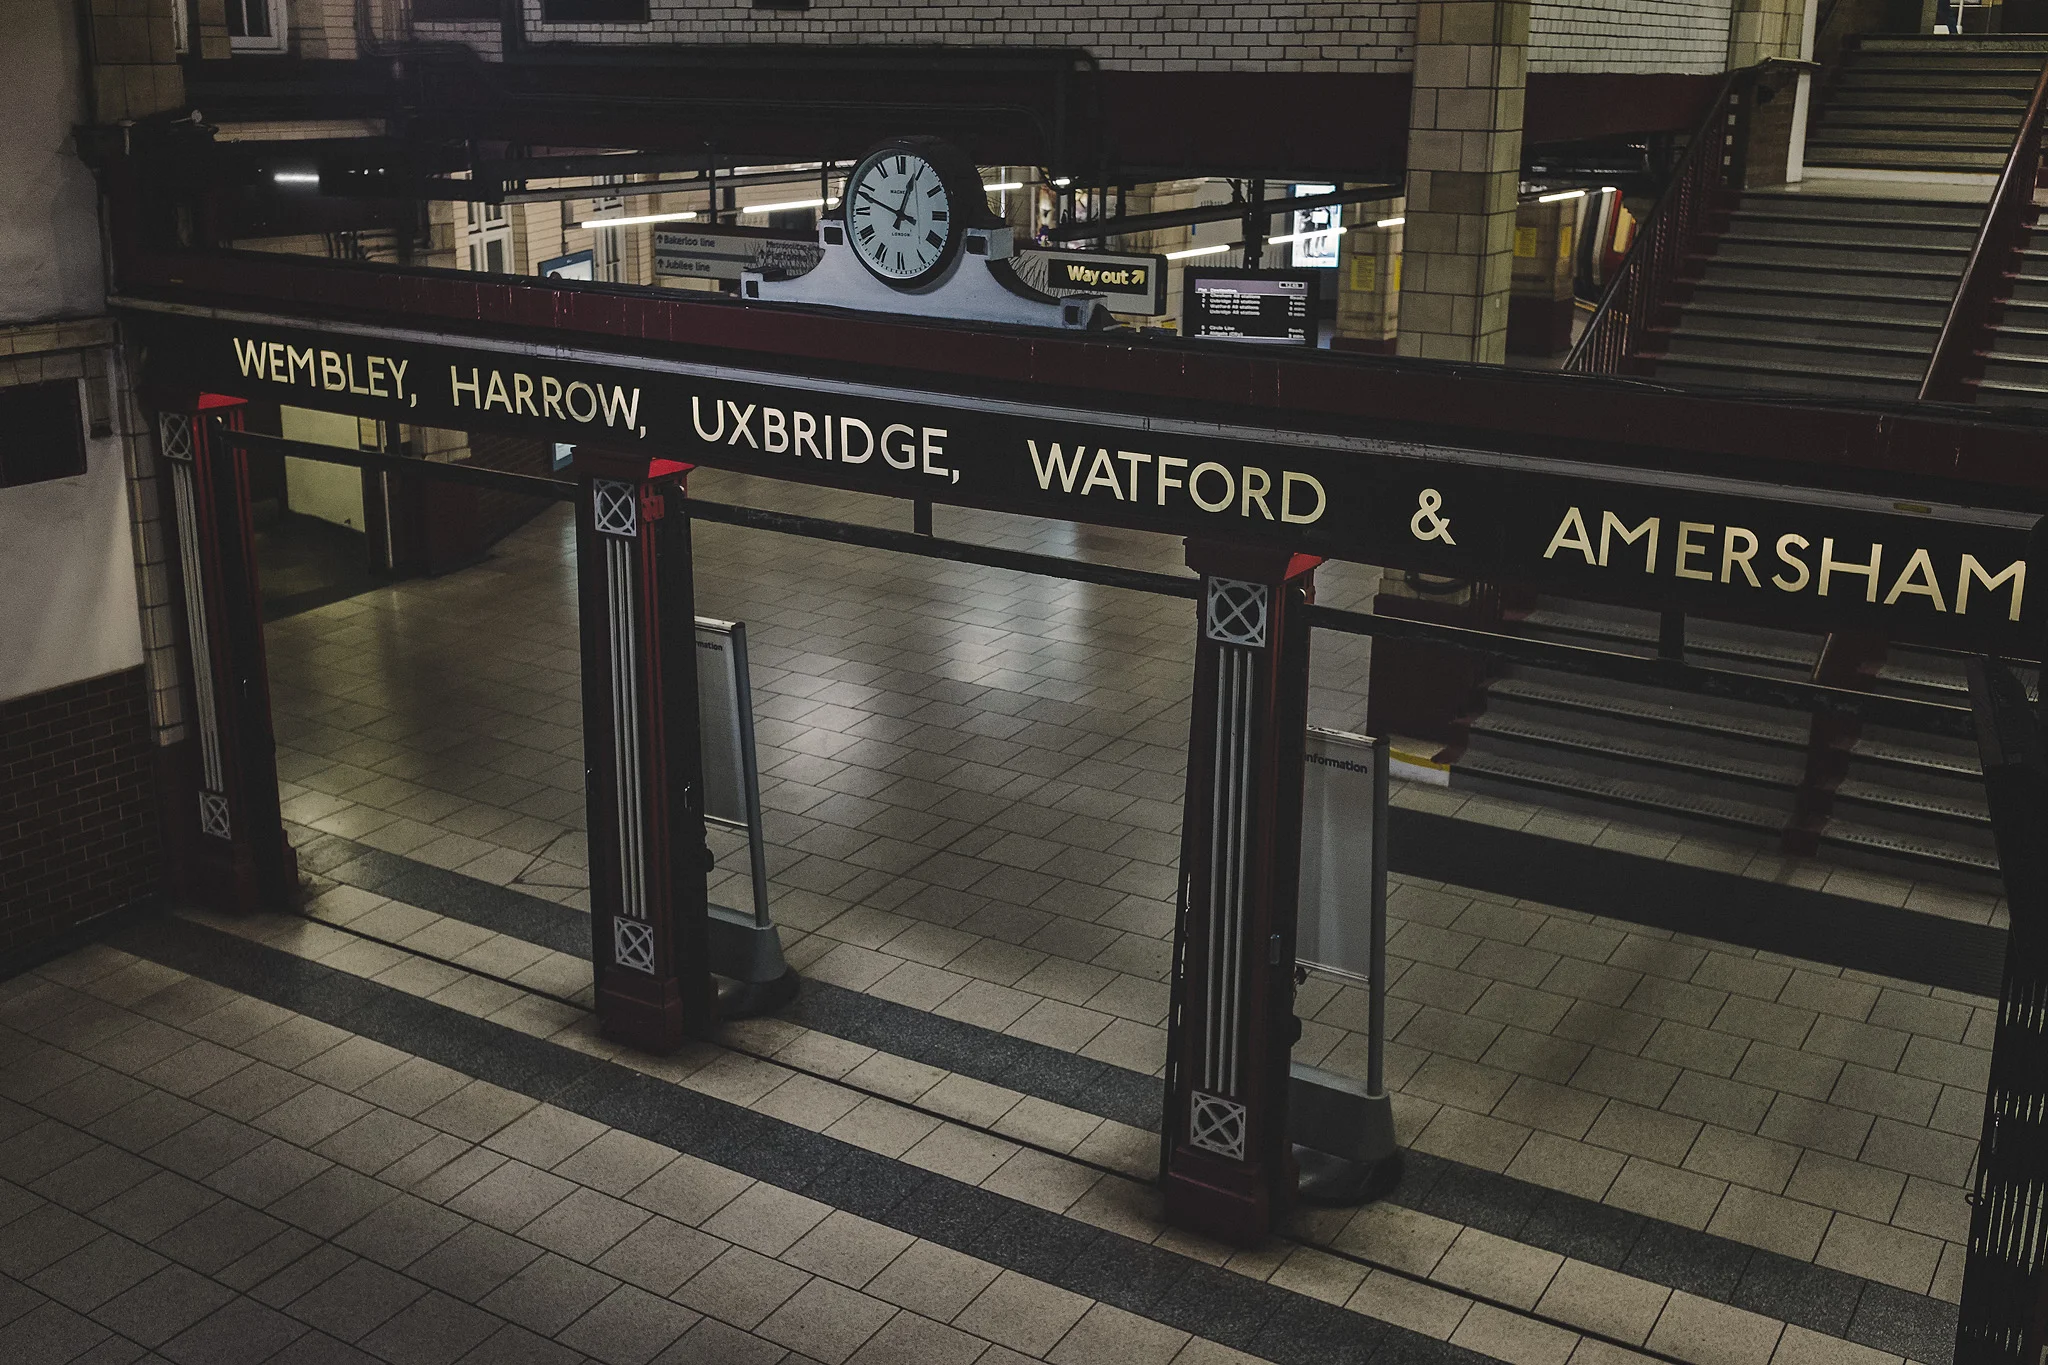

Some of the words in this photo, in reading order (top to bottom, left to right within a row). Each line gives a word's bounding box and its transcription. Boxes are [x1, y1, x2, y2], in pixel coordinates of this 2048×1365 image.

[664, 235, 698, 246] Bakerloo
[700, 238, 715, 248] line
[665, 260, 693, 271] Jubilee
[696, 262, 710, 272] line
[1066, 264, 1101, 286] Way
[1101, 269, 1129, 285] out
[232, 337, 418, 408] WEMBLEY,
[450, 365, 646, 438] HARROW,
[691, 395, 960, 485] UXBRIDGE,
[1026, 439, 1329, 526] WATFORD
[1410, 488, 1457, 546] &
[1543, 506, 2027, 622] AMERSHAM
